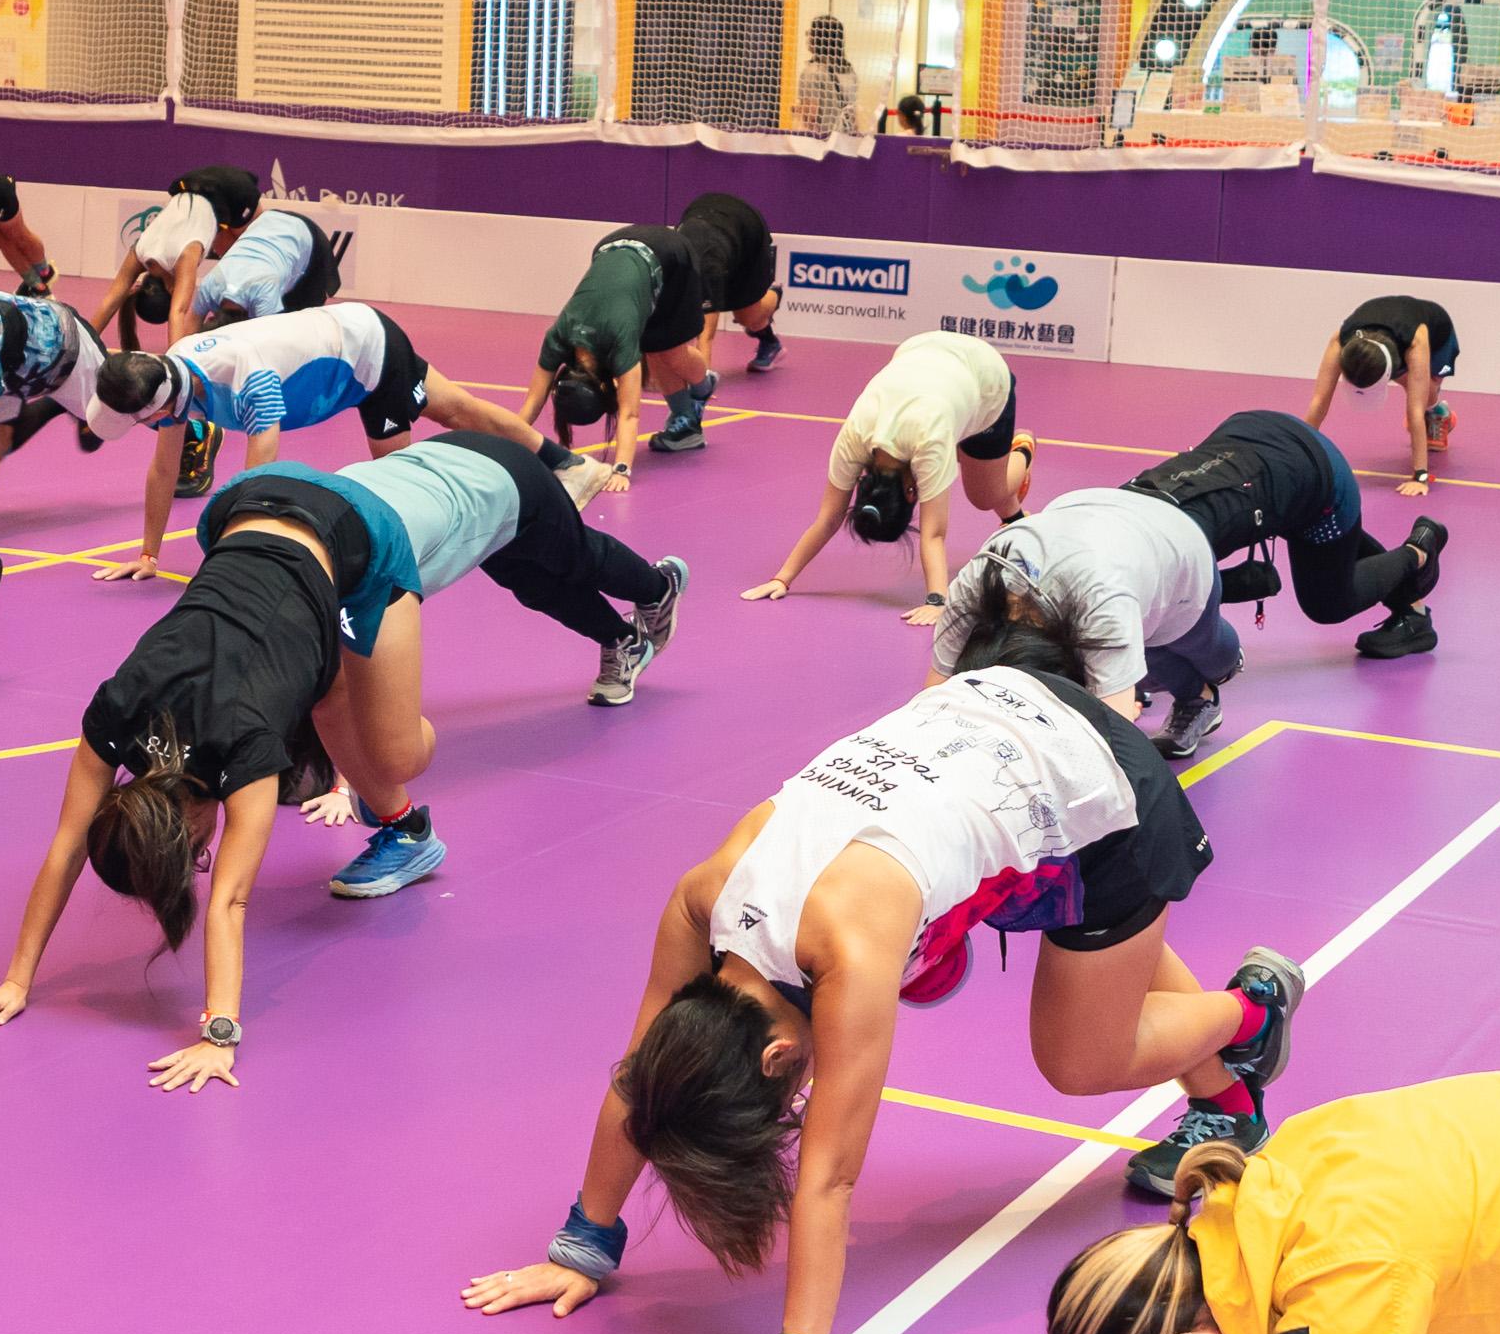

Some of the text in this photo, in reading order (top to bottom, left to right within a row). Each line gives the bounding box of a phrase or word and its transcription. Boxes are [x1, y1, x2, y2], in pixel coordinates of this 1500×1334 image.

[793, 263, 906, 291] sanwall
[786, 300, 906, 321] www.sanwall.hk
[825, 757, 899, 793] BRINGS
[866, 754, 896, 771] US
[800, 766, 888, 812] RUNNING
